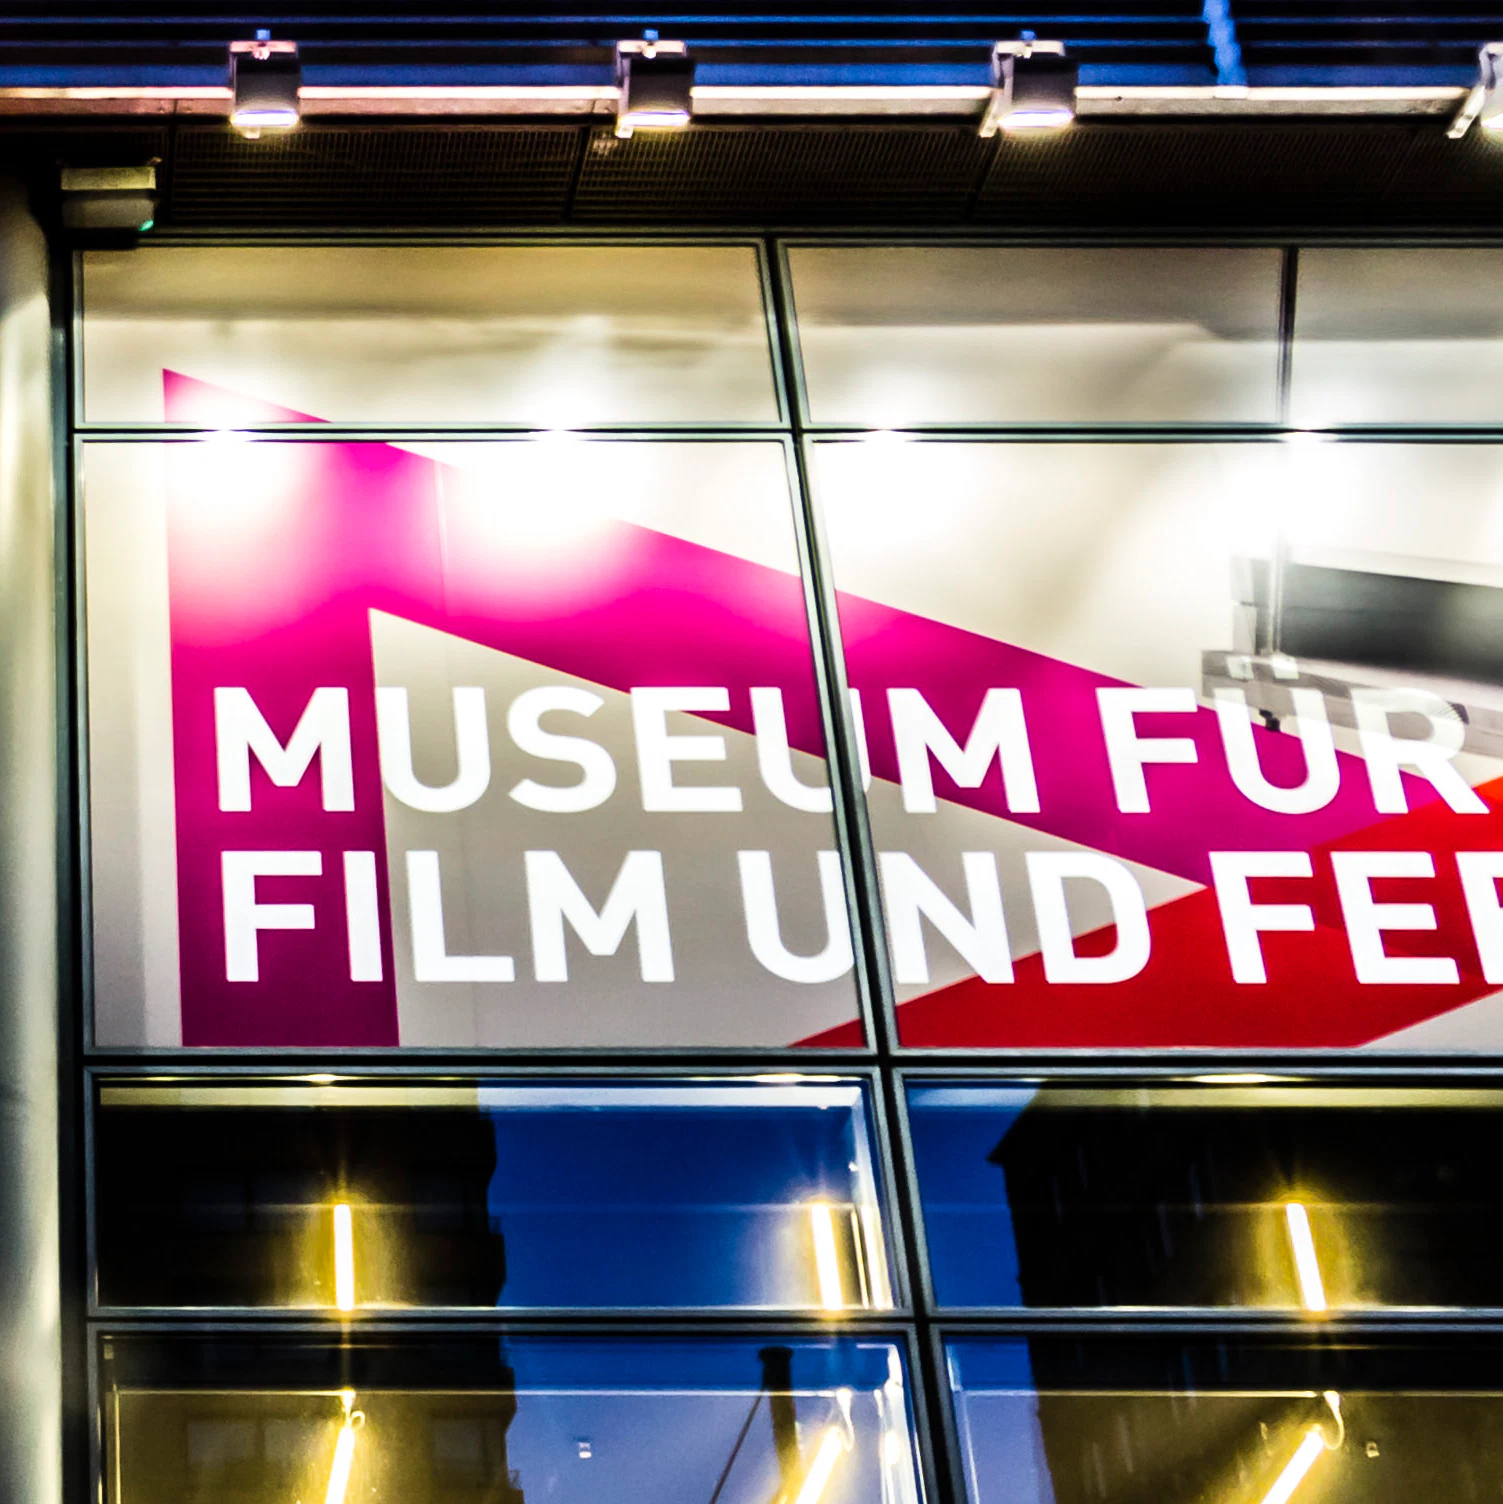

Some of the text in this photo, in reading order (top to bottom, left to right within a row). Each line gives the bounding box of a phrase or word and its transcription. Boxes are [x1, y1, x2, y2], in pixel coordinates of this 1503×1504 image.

[214, 685, 1041, 813] MUSEUM
[220, 850, 676, 983] FILM
[736, 850, 1152, 985] UND
